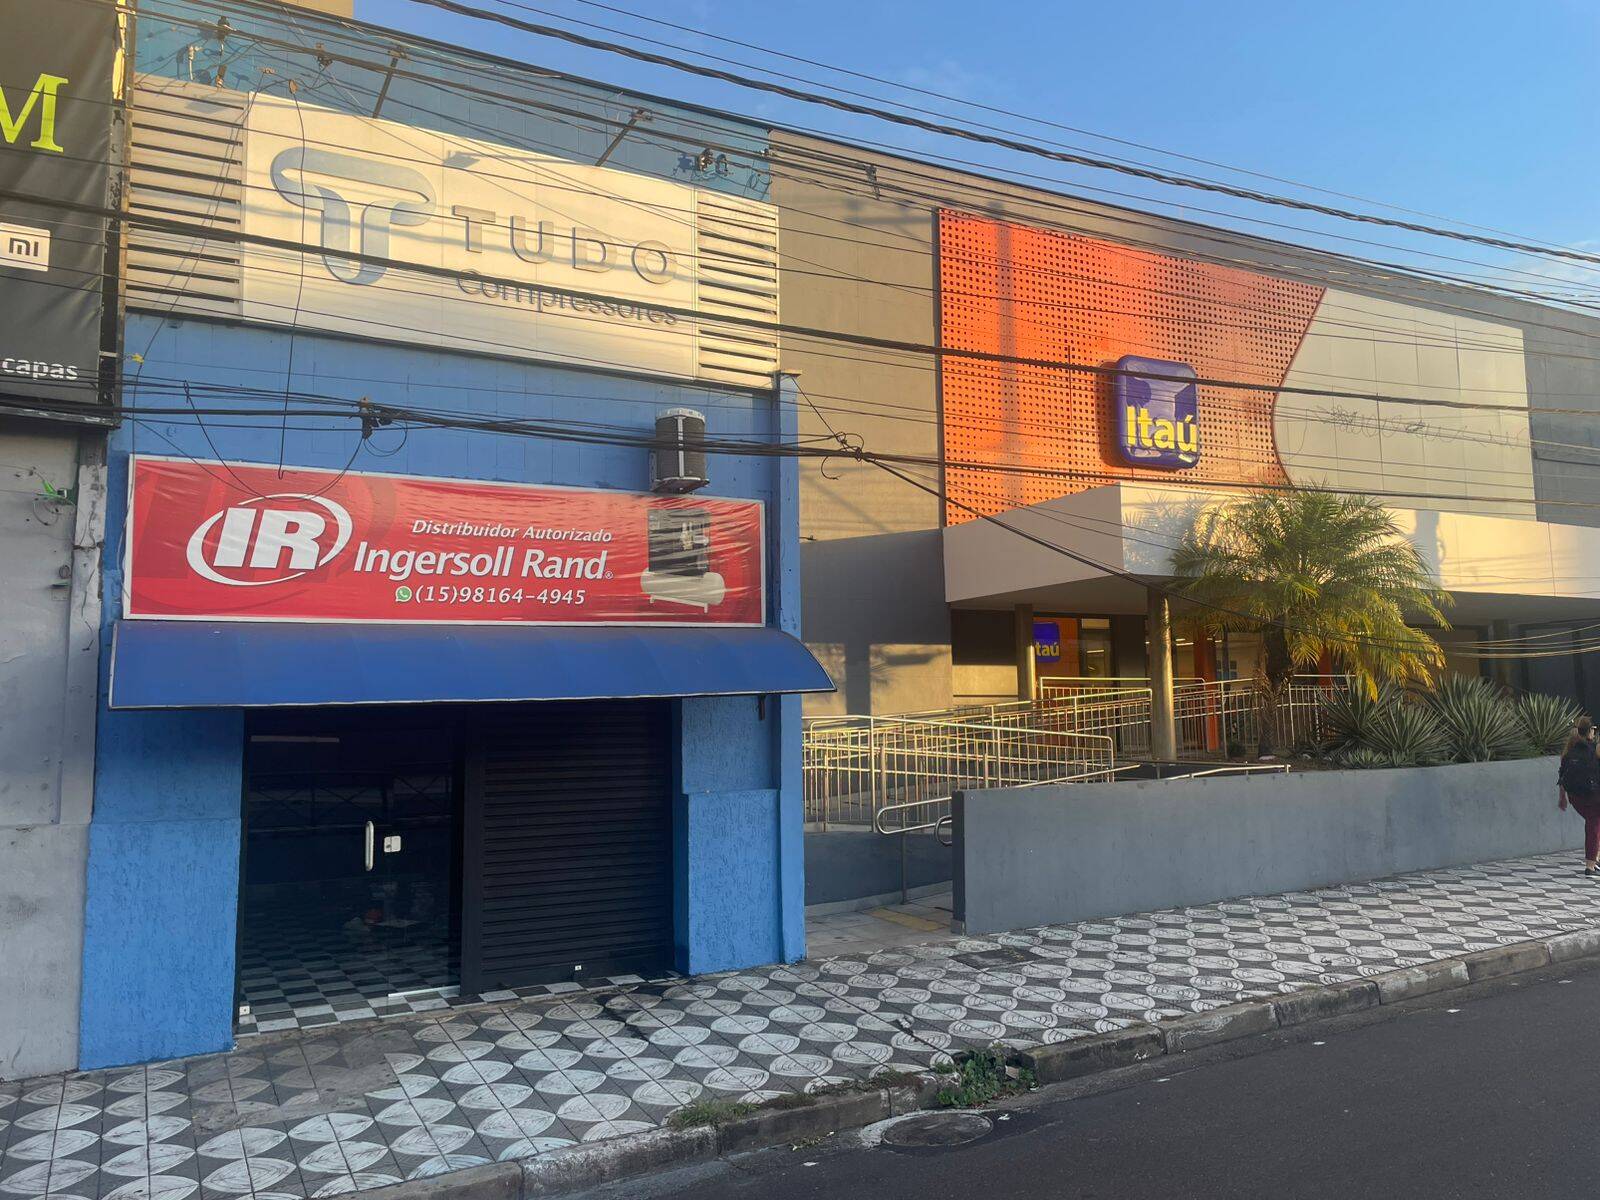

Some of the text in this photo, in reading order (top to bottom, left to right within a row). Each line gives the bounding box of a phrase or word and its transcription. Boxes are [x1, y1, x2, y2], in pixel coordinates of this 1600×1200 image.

[451, 205, 678, 284] TUDO
[2, 358, 78, 380] capas
[1126, 405, 1198, 453] Itaú
[213, 507, 326, 570] IR
[411, 519, 612, 542] Distribuidor Autorizado
[353, 541, 515, 581] Ingersoll
[415, 585, 586, 605] (15)98164-4945
[1035, 641, 1060, 657] taú
